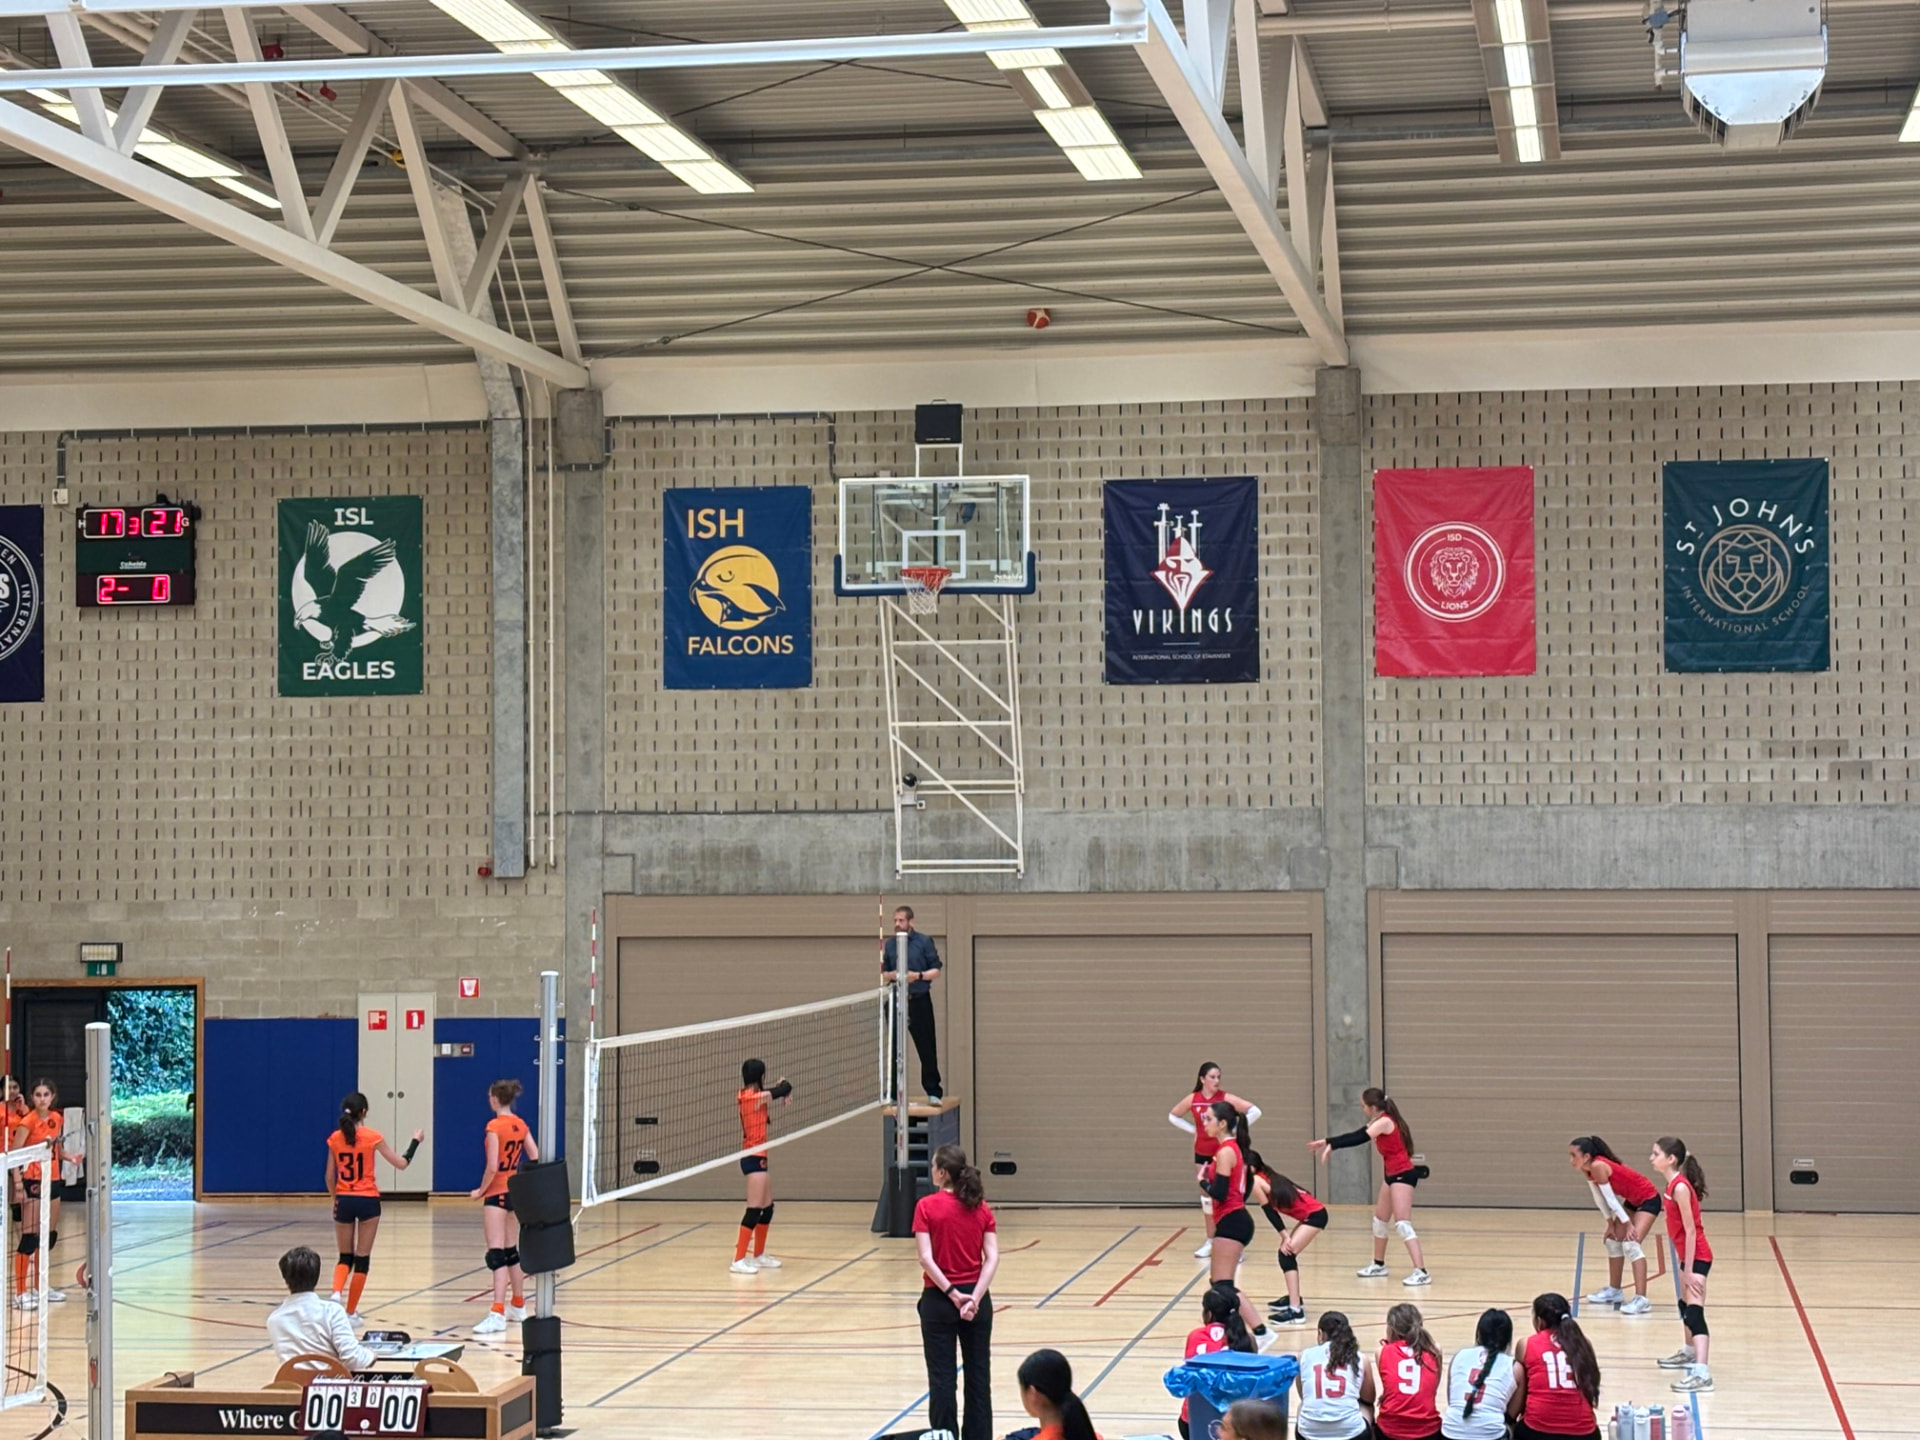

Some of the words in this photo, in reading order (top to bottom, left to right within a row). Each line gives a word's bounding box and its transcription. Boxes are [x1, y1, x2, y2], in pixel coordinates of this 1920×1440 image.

[101, 511, 123, 535] 17
[128, 516, 140, 535] 3
[150, 510, 182, 535] 21
[181, 517, 190, 528] G
[334, 507, 374, 526] ISL
[688, 508, 745, 539] ISH
[1447, 533, 1463, 542] ISD
[1440, 600, 1470, 611] LIONS
[1681, 586, 1769, 634] INTERNATIONAL
[1771, 584, 1810, 626] SCHOOL
[1133, 607, 1233, 635] VIKINGS
[688, 635, 794, 655] FALCONS
[302, 661, 396, 681] EAGLES
[339, 1152, 364, 1182] 31
[1313, 1364, 1347, 1400] 15
[1397, 1358, 1421, 1394] 9
[350, 1391, 358, 1405] 3
[218, 1409, 284, 1430] Where
